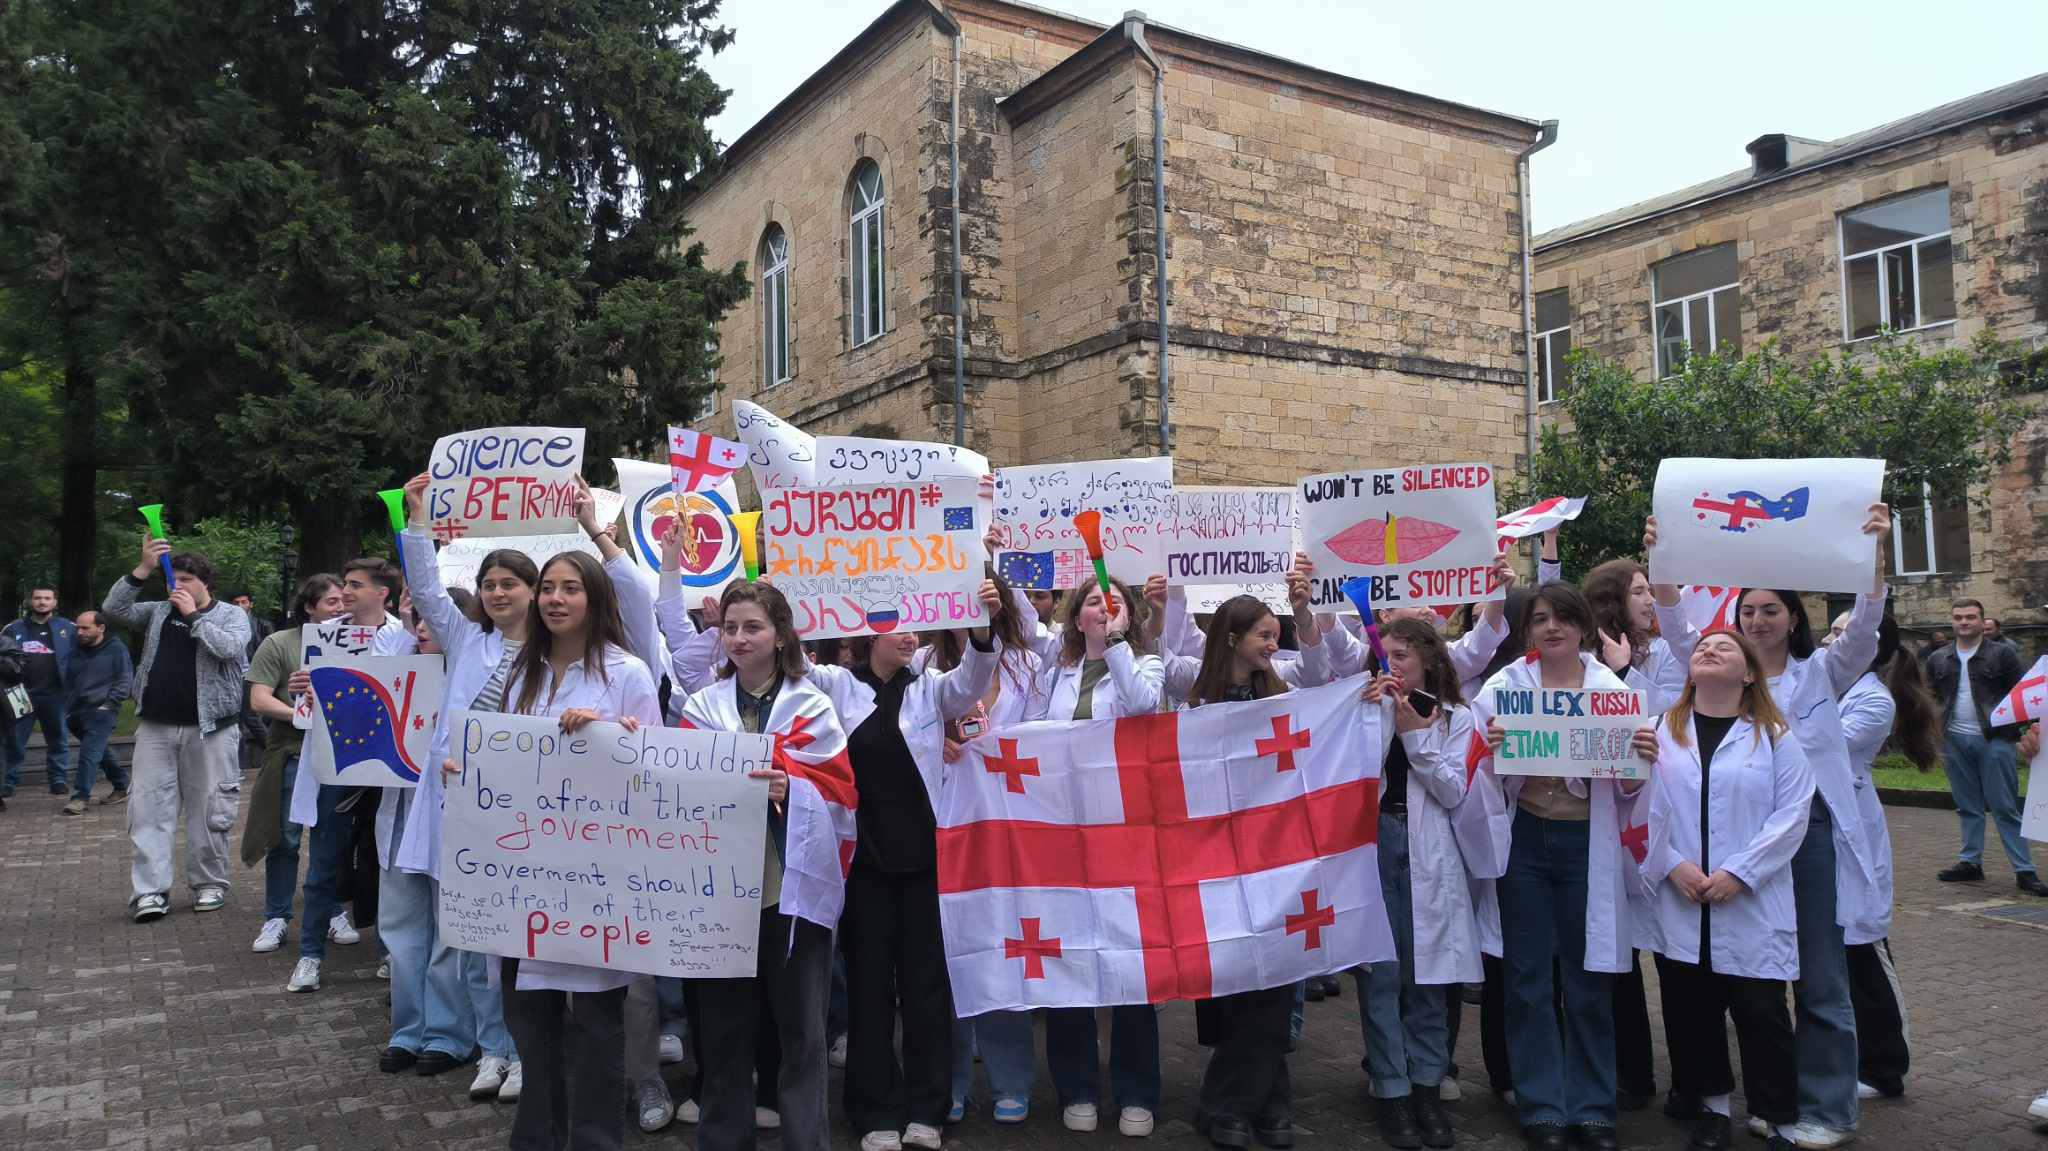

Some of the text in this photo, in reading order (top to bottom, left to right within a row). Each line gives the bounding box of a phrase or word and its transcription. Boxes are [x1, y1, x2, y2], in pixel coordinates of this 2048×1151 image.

[432, 436, 576, 480] Silence
[1303, 466, 1490, 504] WON'T BE SILENCED
[769, 487, 916, 537] ქუჩებში
[1310, 573, 1356, 606] CAN'
[1370, 574, 1400, 601] BE
[1408, 566, 1501, 599] STOPPED
[317, 628, 350, 648] WE
[1496, 690, 1641, 717] NON LEX RUSSIA
[1502, 727, 1635, 761] ETIAM EUROP
[477, 767, 737, 822] be afraid of their
[495, 811, 721, 854] goverment
[455, 848, 761, 899] Goverment should be
[490, 885, 569, 913] afraid
[592, 894, 615, 916] of
[631, 897, 705, 922] their
